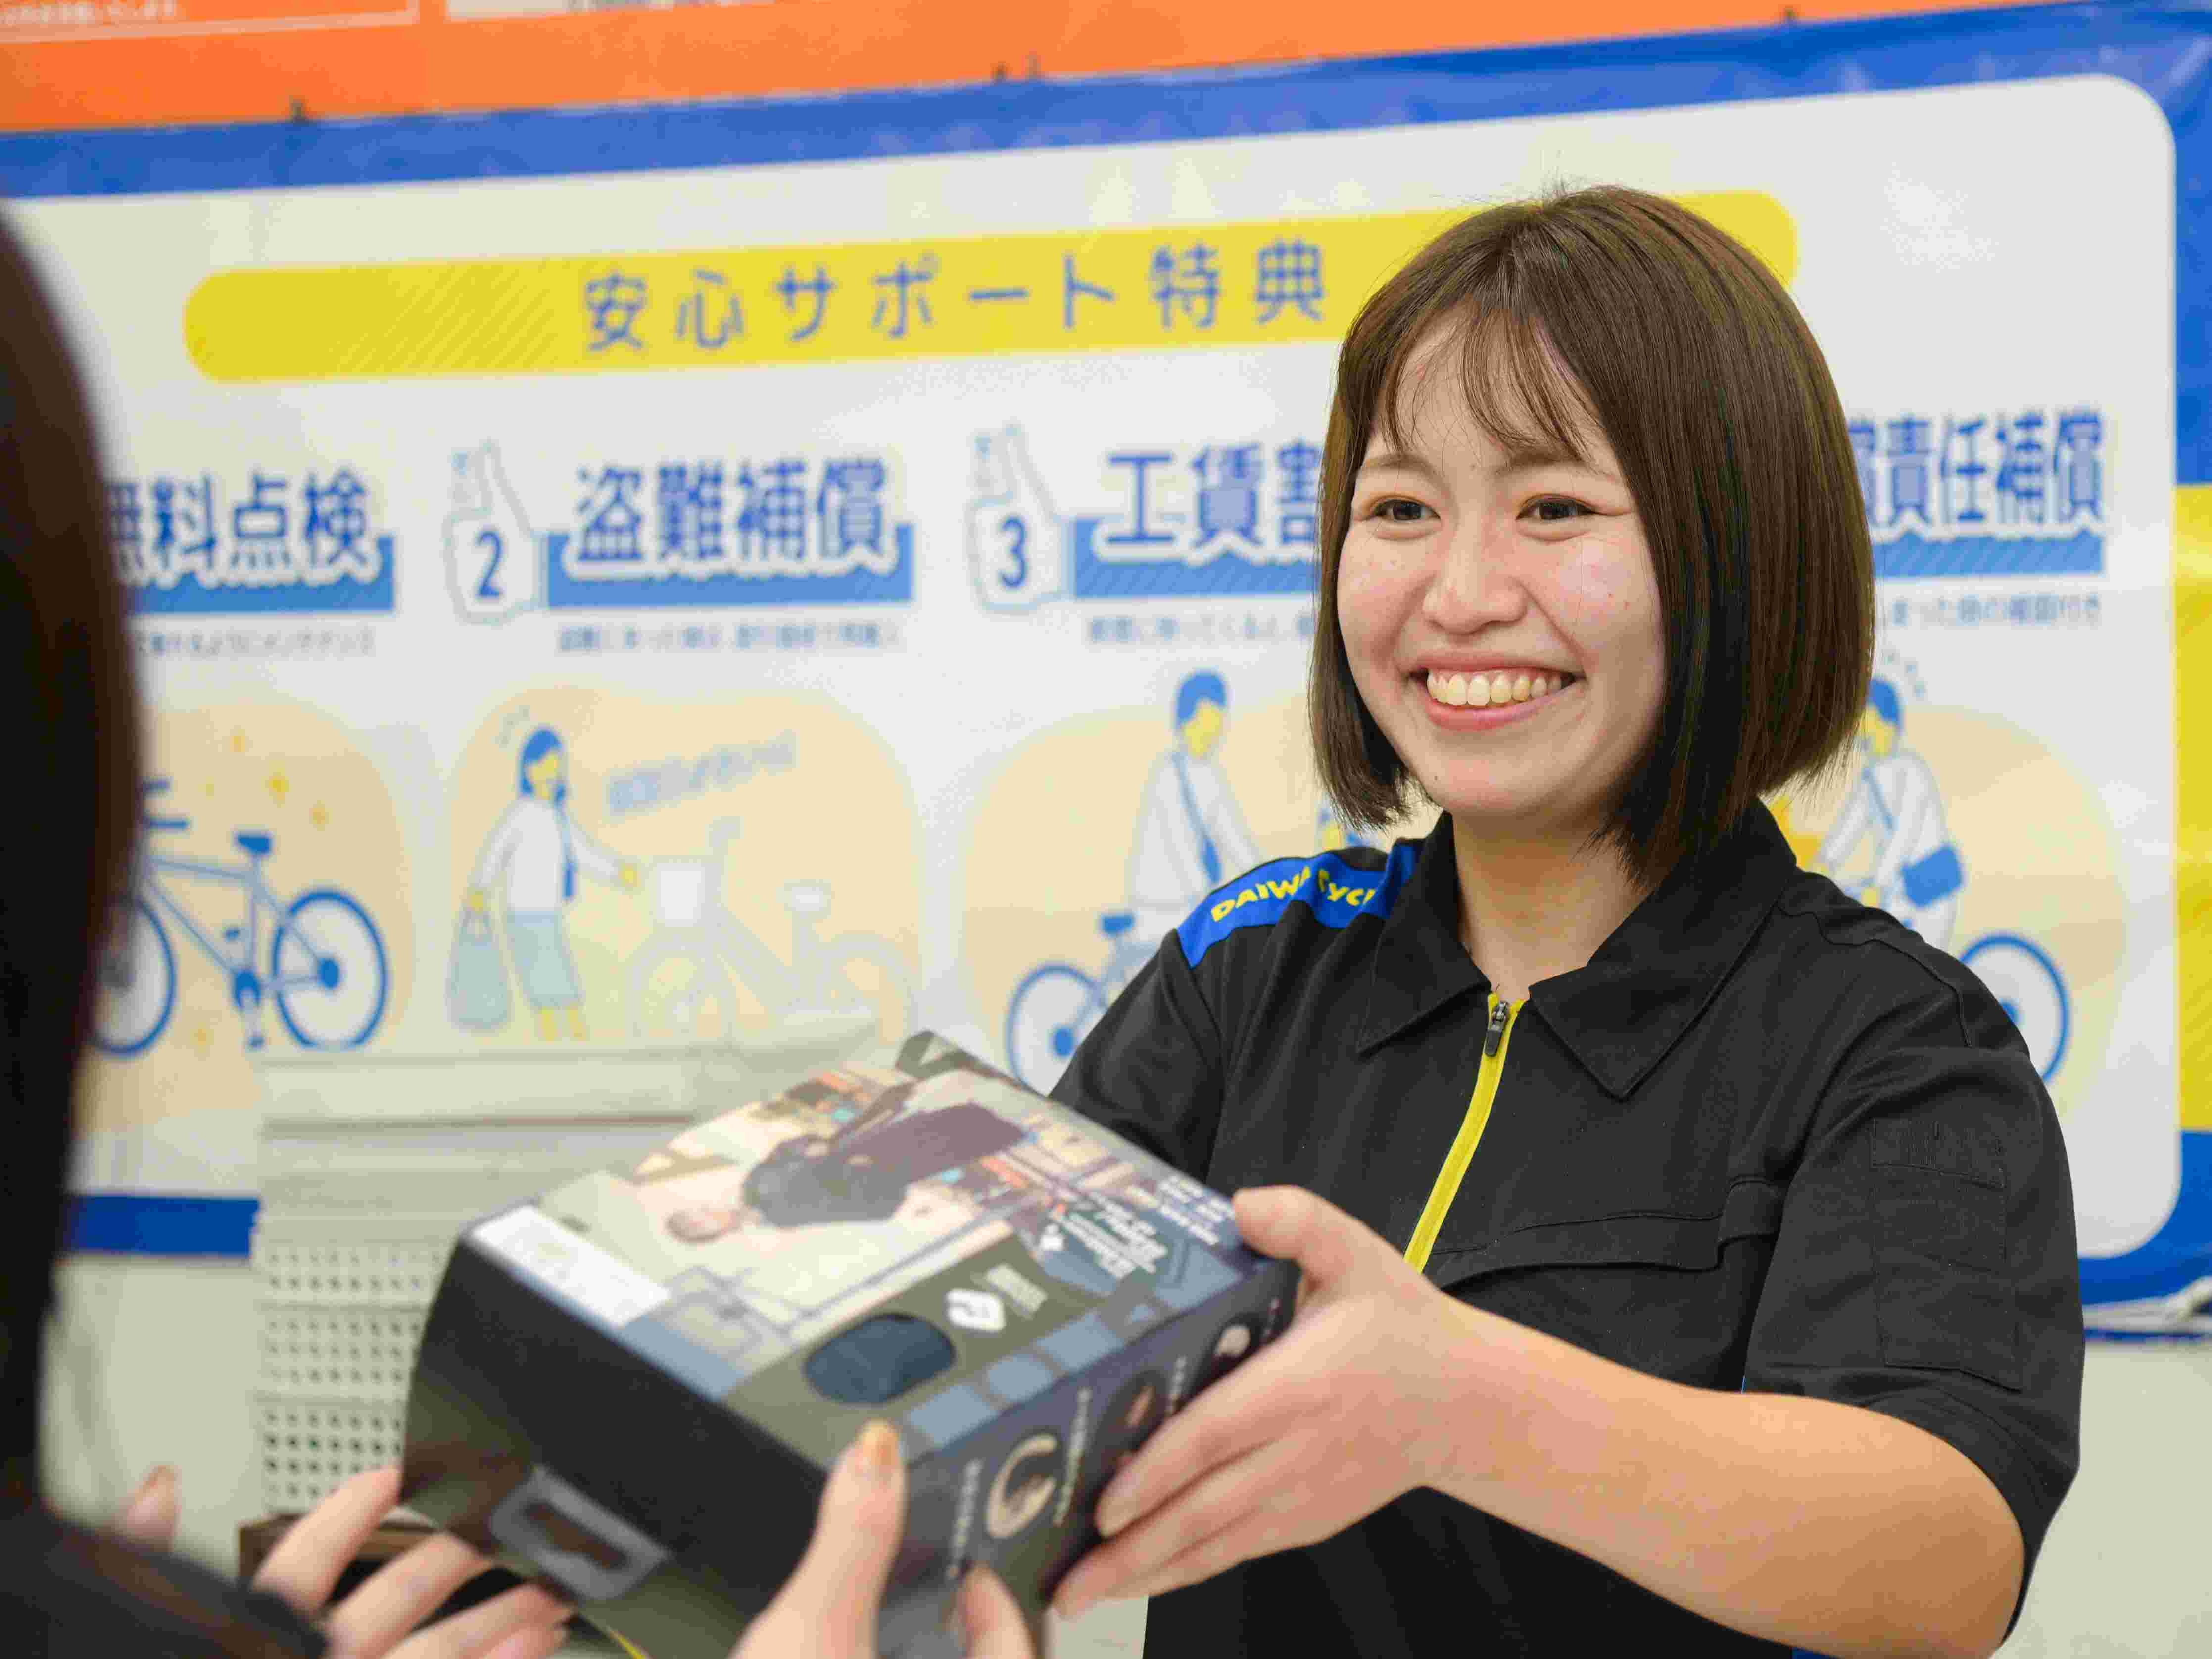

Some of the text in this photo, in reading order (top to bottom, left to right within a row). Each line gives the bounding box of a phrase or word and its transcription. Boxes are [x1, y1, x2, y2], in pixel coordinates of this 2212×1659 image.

[584, 240, 1325, 352] 安心サポート特典
[577, 459, 887, 563] 盗難補償
[998, 515, 1029, 590] 3
[475, 529, 504, 599] 2
